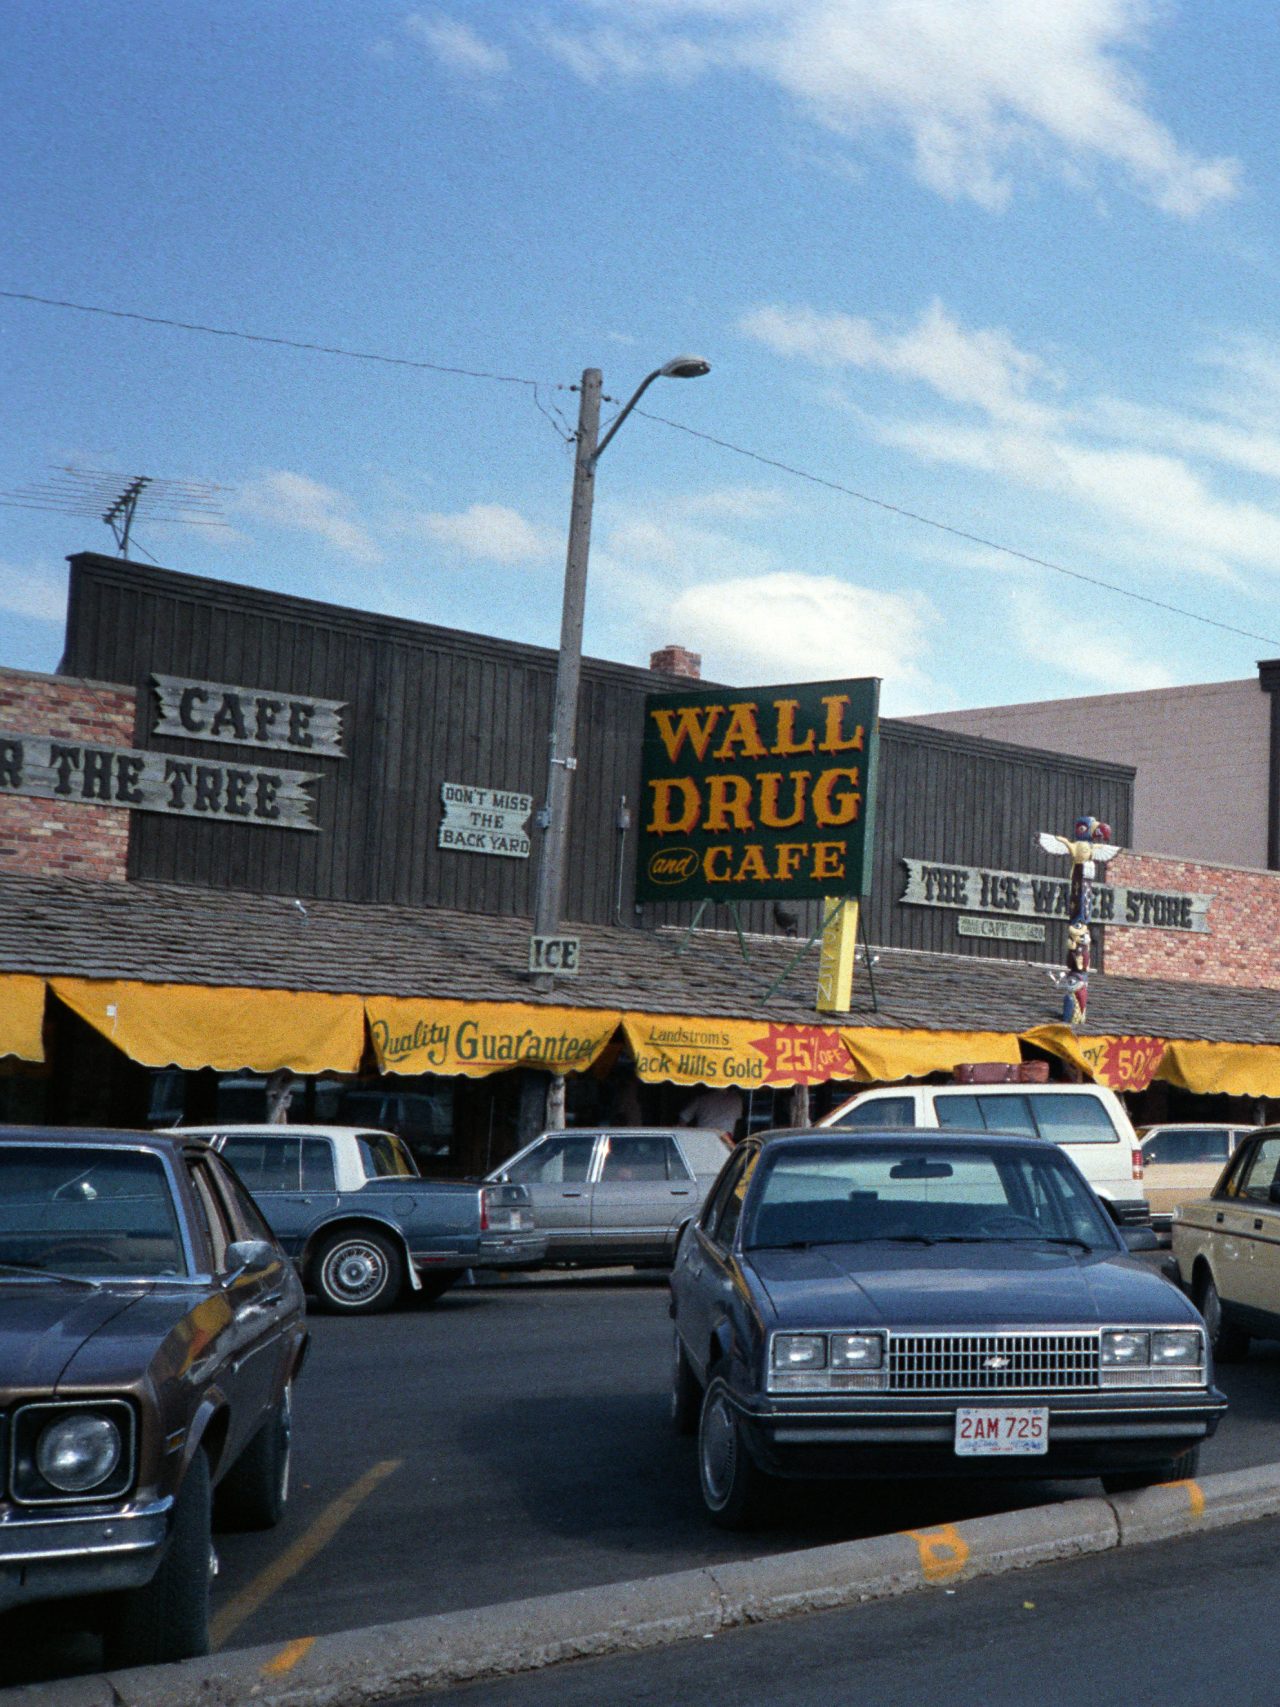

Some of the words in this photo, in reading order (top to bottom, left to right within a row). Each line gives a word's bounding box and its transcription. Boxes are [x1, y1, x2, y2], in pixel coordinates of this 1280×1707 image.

[179, 687, 315, 748] CAFE
[650, 695, 864, 763] WALL
[50, 744, 146, 802] THE
[164, 759, 283, 819] TREE
[446, 787, 486, 805] DON'T
[493, 794, 529, 811] MISS
[647, 767, 861, 836] DRUG
[471, 812, 504, 829] THE
[443, 830, 485, 848] BACK
[489, 835, 529, 853] YARD
[652, 854, 694, 877] and
[703, 841, 849, 884] CAFE
[921, 865, 968, 905] THE
[980, 872, 1020, 911] ICE
[1031, 879, 1114, 921] WAER
[1126, 890, 1193, 929] STORE
[533, 939, 577, 970] ICE
[371, 1020, 451, 1065] Quality
[649, 1026, 730, 1046] Landstrom's
[776, 1036, 824, 1073] 25%
[636, 1053, 671, 1075] lack
[677, 1054, 717, 1077] Hills
[723, 1057, 763, 1079] Gold
[961, 1417, 1000, 1439] 2AM
[1005, 1416, 1043, 1438] 725
